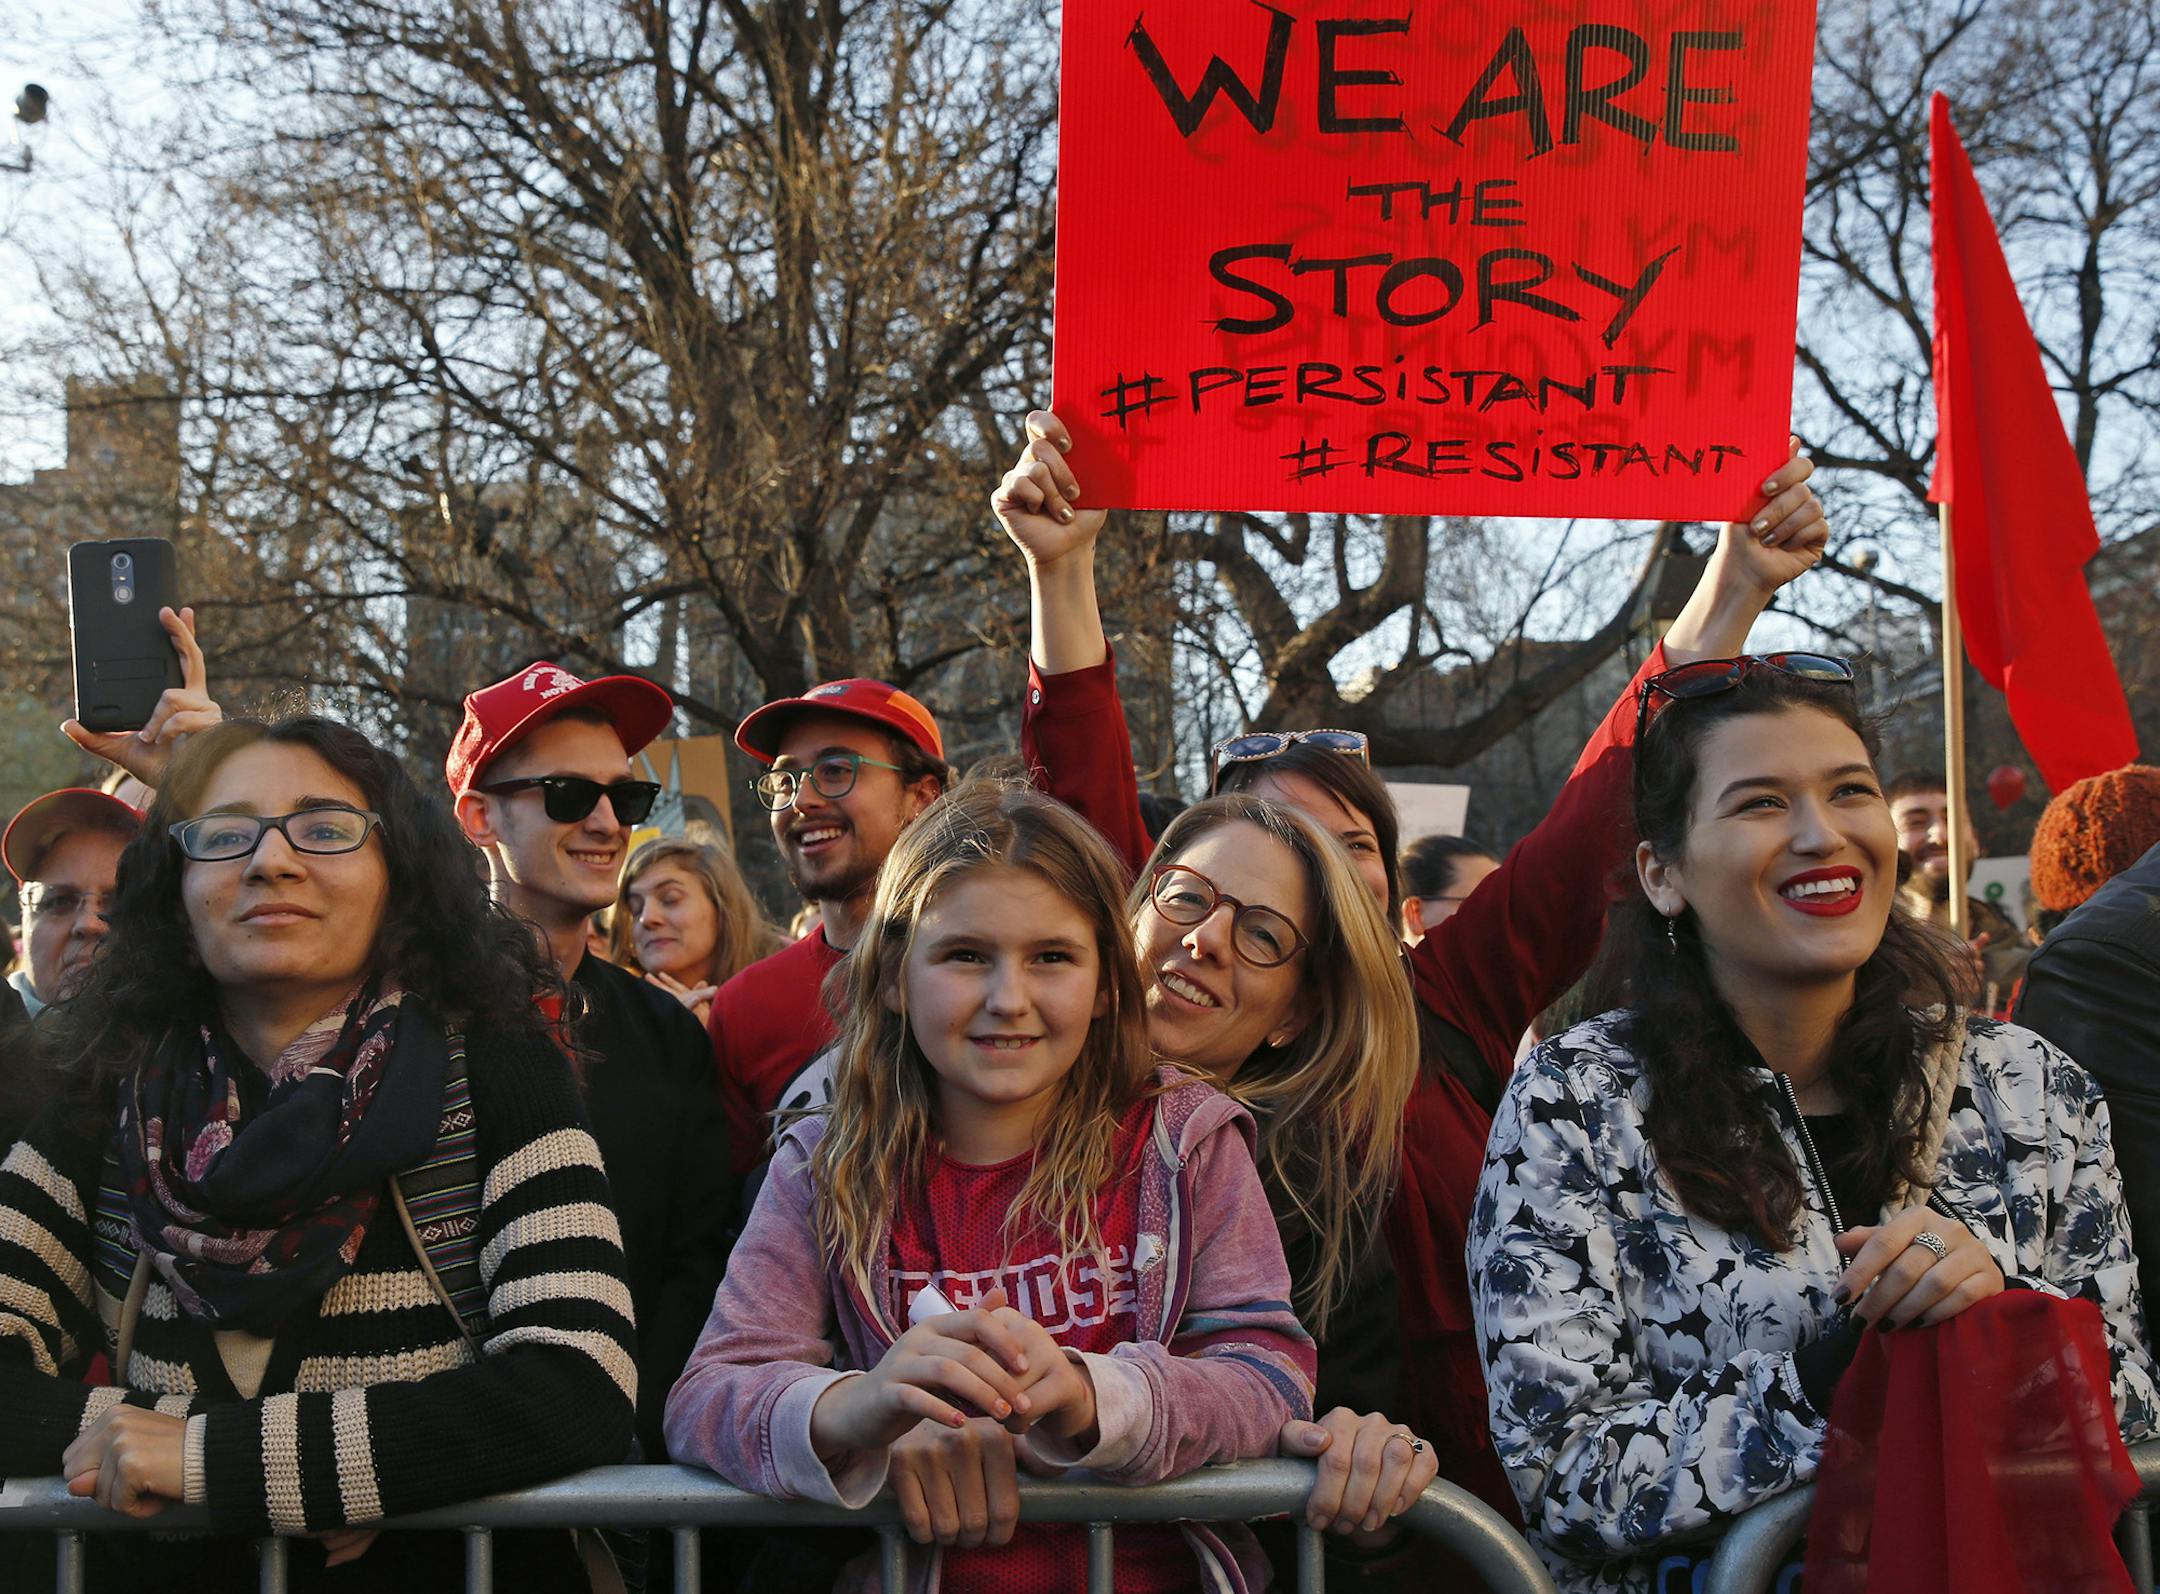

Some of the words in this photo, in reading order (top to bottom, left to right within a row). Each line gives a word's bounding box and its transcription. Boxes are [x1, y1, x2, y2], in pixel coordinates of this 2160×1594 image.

[1124, 0, 1413, 140] WE
[1431, 23, 1745, 161] ARE
[1347, 176, 1527, 227] THE
[1198, 243, 1682, 350] STORY
